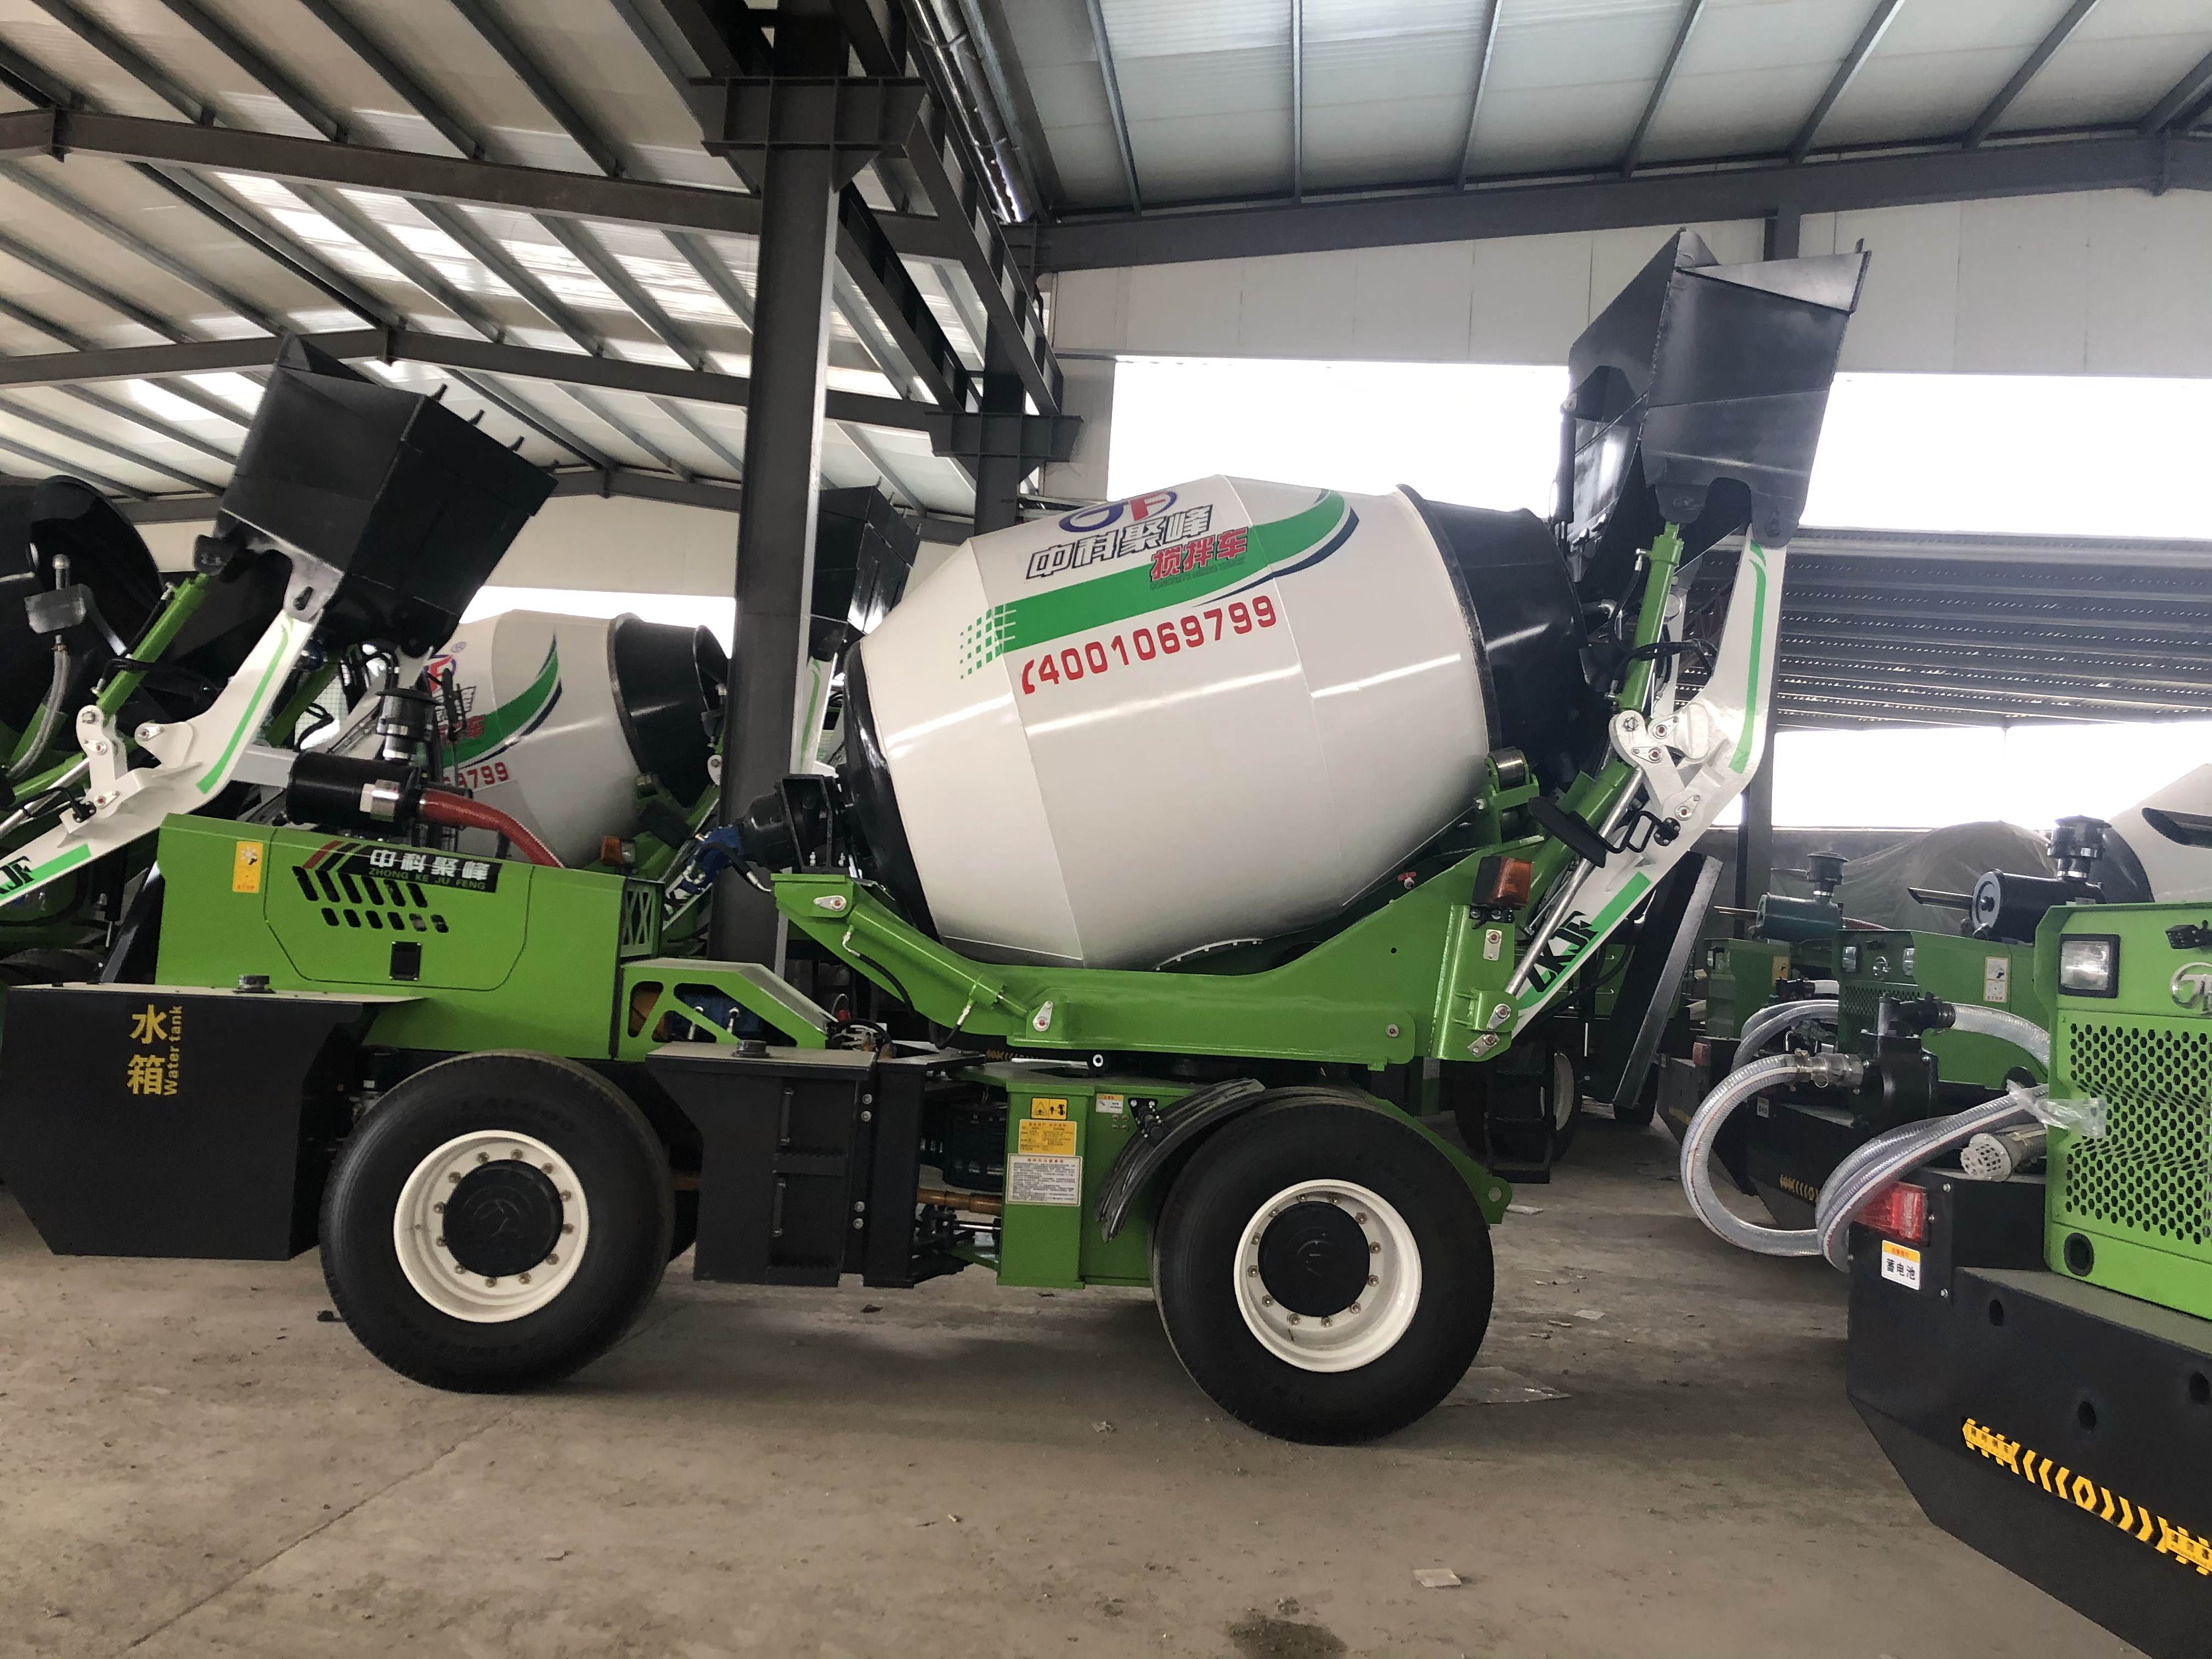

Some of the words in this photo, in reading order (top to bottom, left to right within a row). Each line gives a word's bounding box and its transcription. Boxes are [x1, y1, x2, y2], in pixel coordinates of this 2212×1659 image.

[1025, 504, 1213, 580] 中科聚峰
[1150, 527, 1249, 582] 搅拌车
[1039, 596, 1276, 685] 4001069799
[369, 867, 409, 878] ZHONG
[415, 873, 430, 882] KE
[435, 877, 450, 885] JU
[456, 879, 486, 890] FENG
[370, 849, 490, 881] 中科聚峰
[127, 1004, 168, 1094] 水箱
[168, 1006, 183, 1042] tank
[163, 1045, 180, 1096] Water
[1886, 1258, 1916, 1280] 蓄电池
